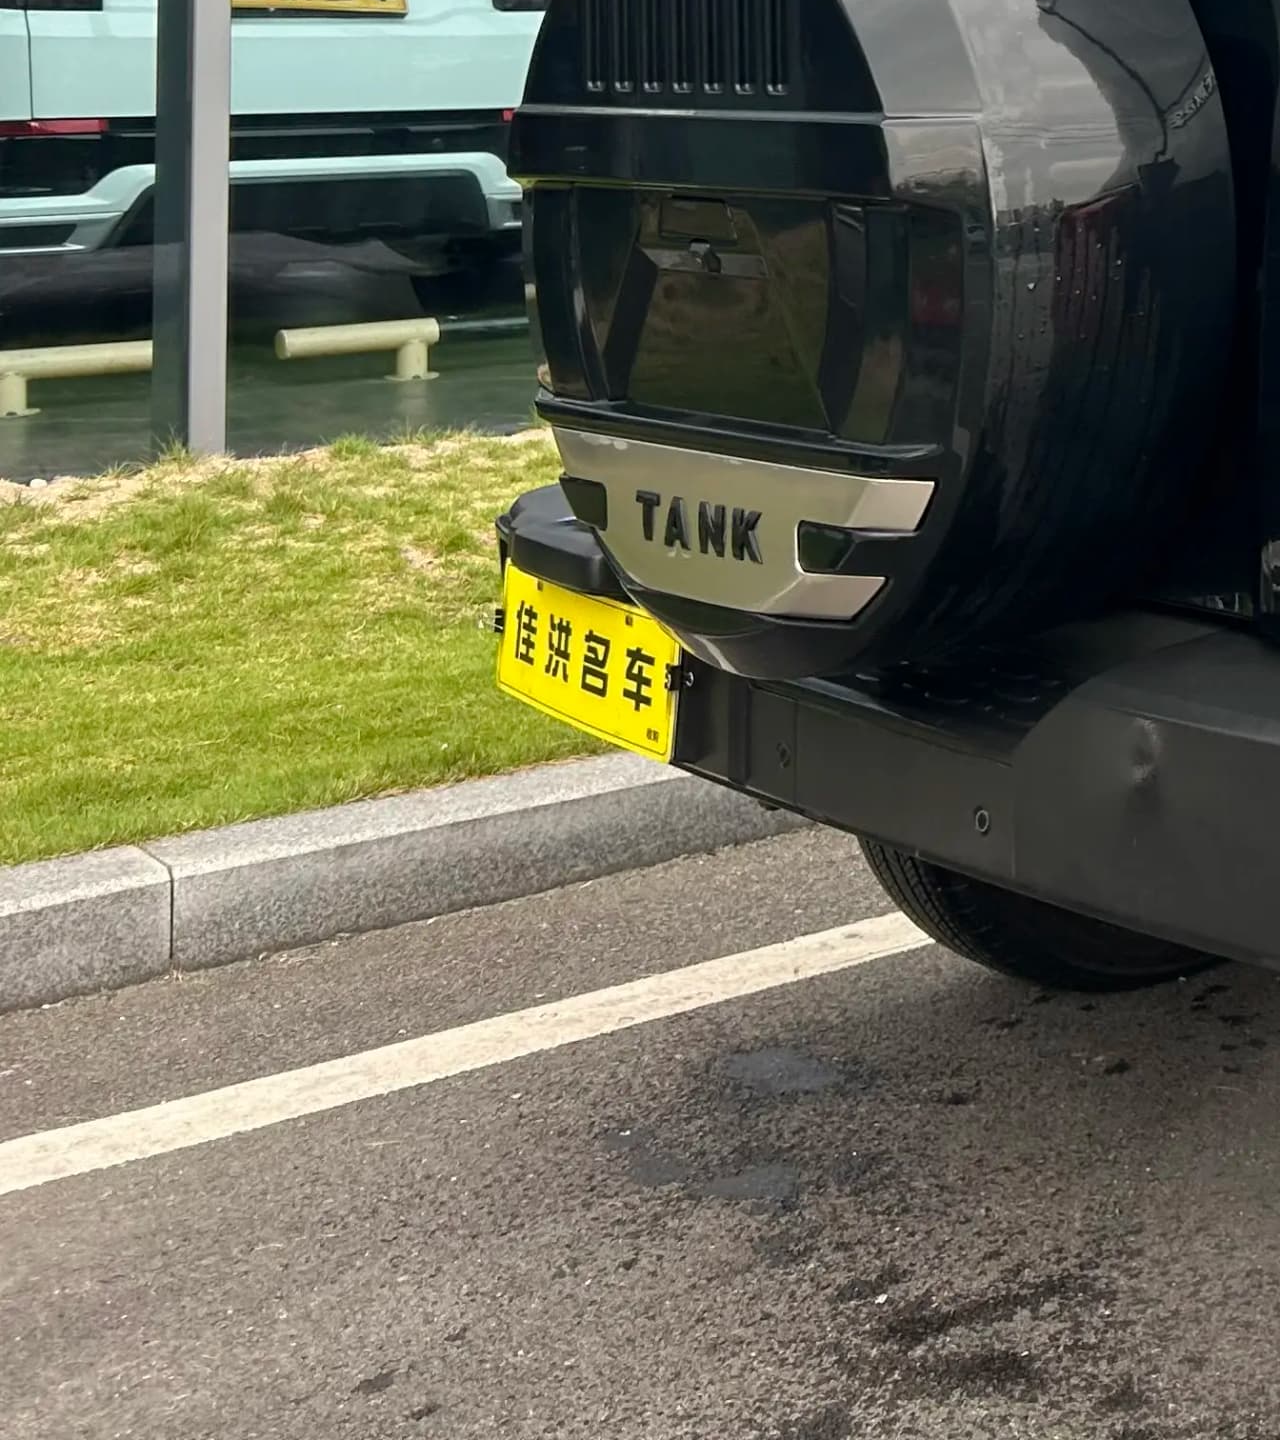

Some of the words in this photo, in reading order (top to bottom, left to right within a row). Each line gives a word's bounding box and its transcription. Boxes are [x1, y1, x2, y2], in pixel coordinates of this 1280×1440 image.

[635, 489, 763, 564] TANK
[515, 599, 656, 712] 佳洪名车
